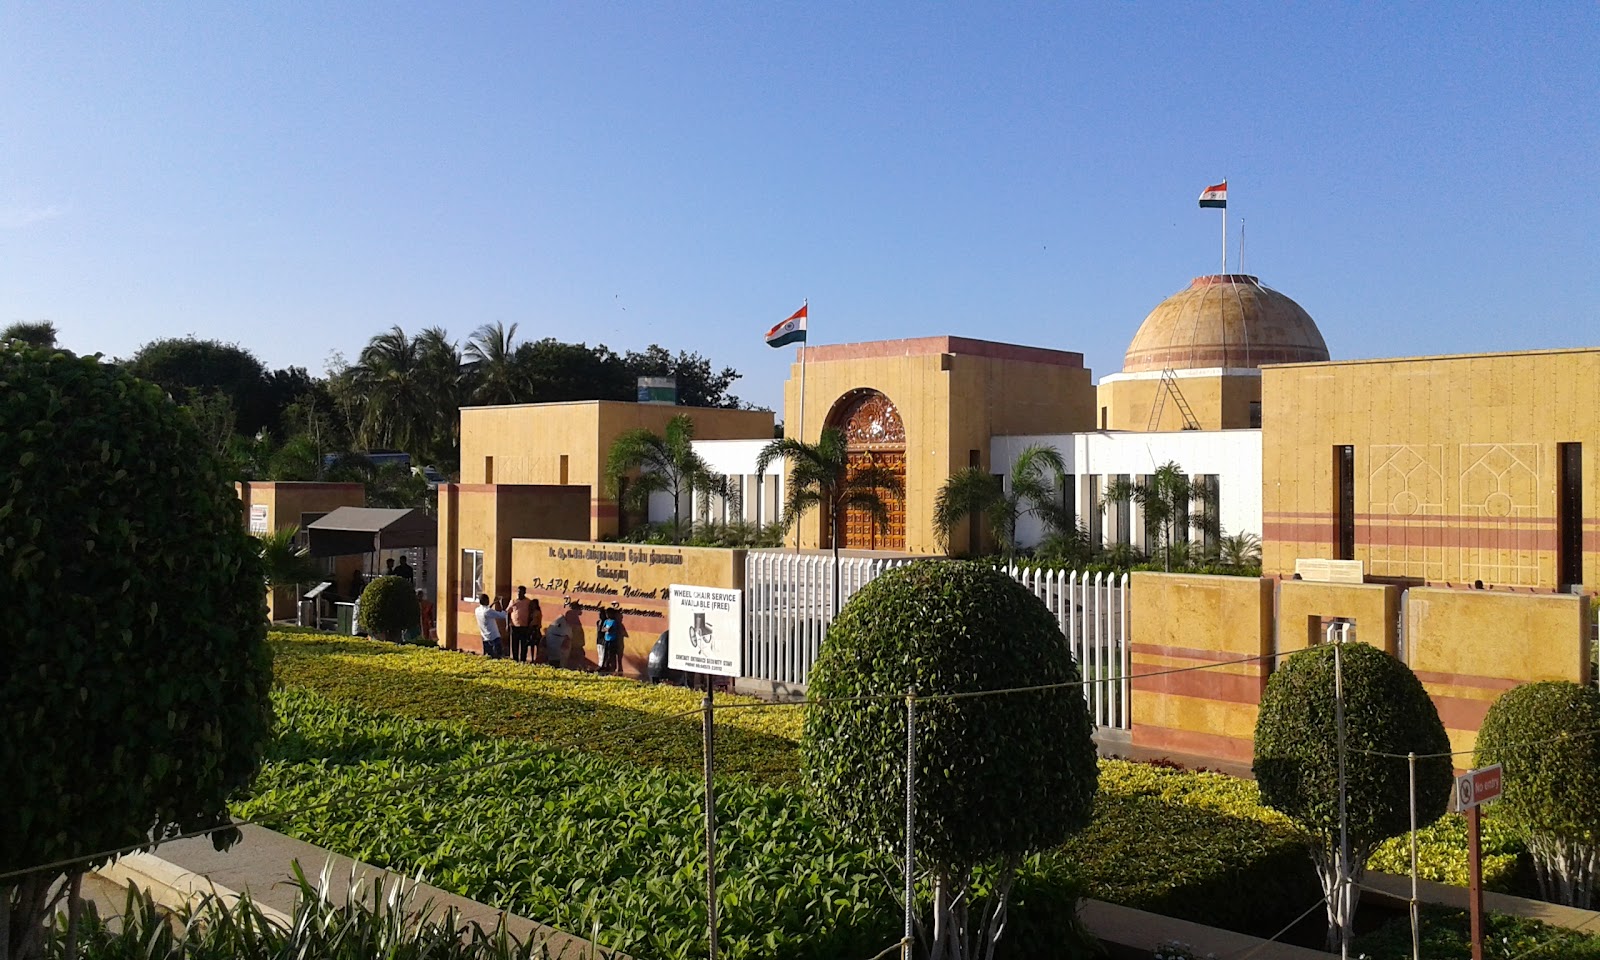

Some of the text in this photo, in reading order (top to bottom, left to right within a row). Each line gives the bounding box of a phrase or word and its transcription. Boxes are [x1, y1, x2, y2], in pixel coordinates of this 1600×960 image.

[622, 585, 656, 598] National
[674, 589, 692, 598] WHEEL
[694, 591, 710, 600] CHAIR
[711, 592, 736, 602] SERVICE
[711, 602, 730, 612] (FREE)
[1475, 778, 1499, 793] No entry
